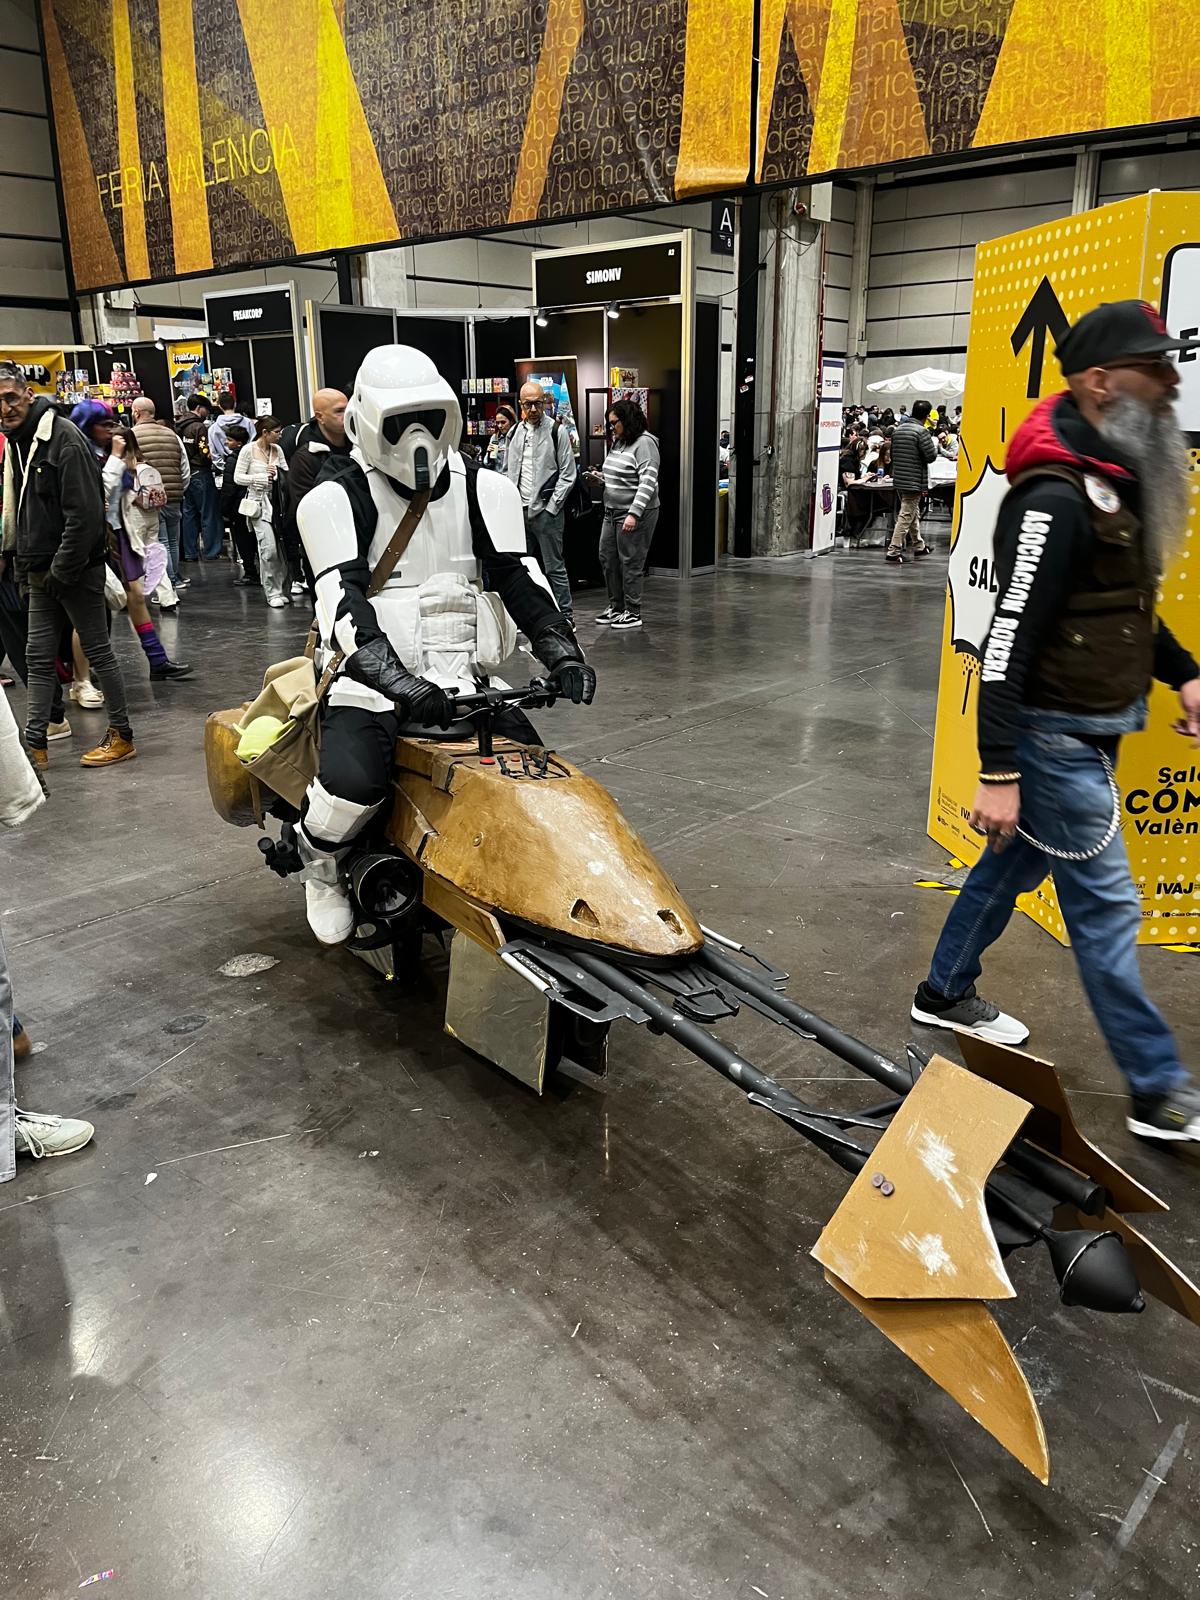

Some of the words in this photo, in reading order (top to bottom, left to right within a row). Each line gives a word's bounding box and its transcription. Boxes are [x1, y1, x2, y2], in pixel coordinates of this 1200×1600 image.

[97, 161, 164, 211] FERIA
[166, 122, 300, 195] VALENCIA
[720, 207, 733, 232] A
[585, 267, 622, 285] SIMONV
[981, 615, 1020, 682] ROKERA
[1157, 766, 1200, 784] Sal
[1134, 817, 1199, 836] Valèn
[1156, 882, 1194, 894] IVAJ
